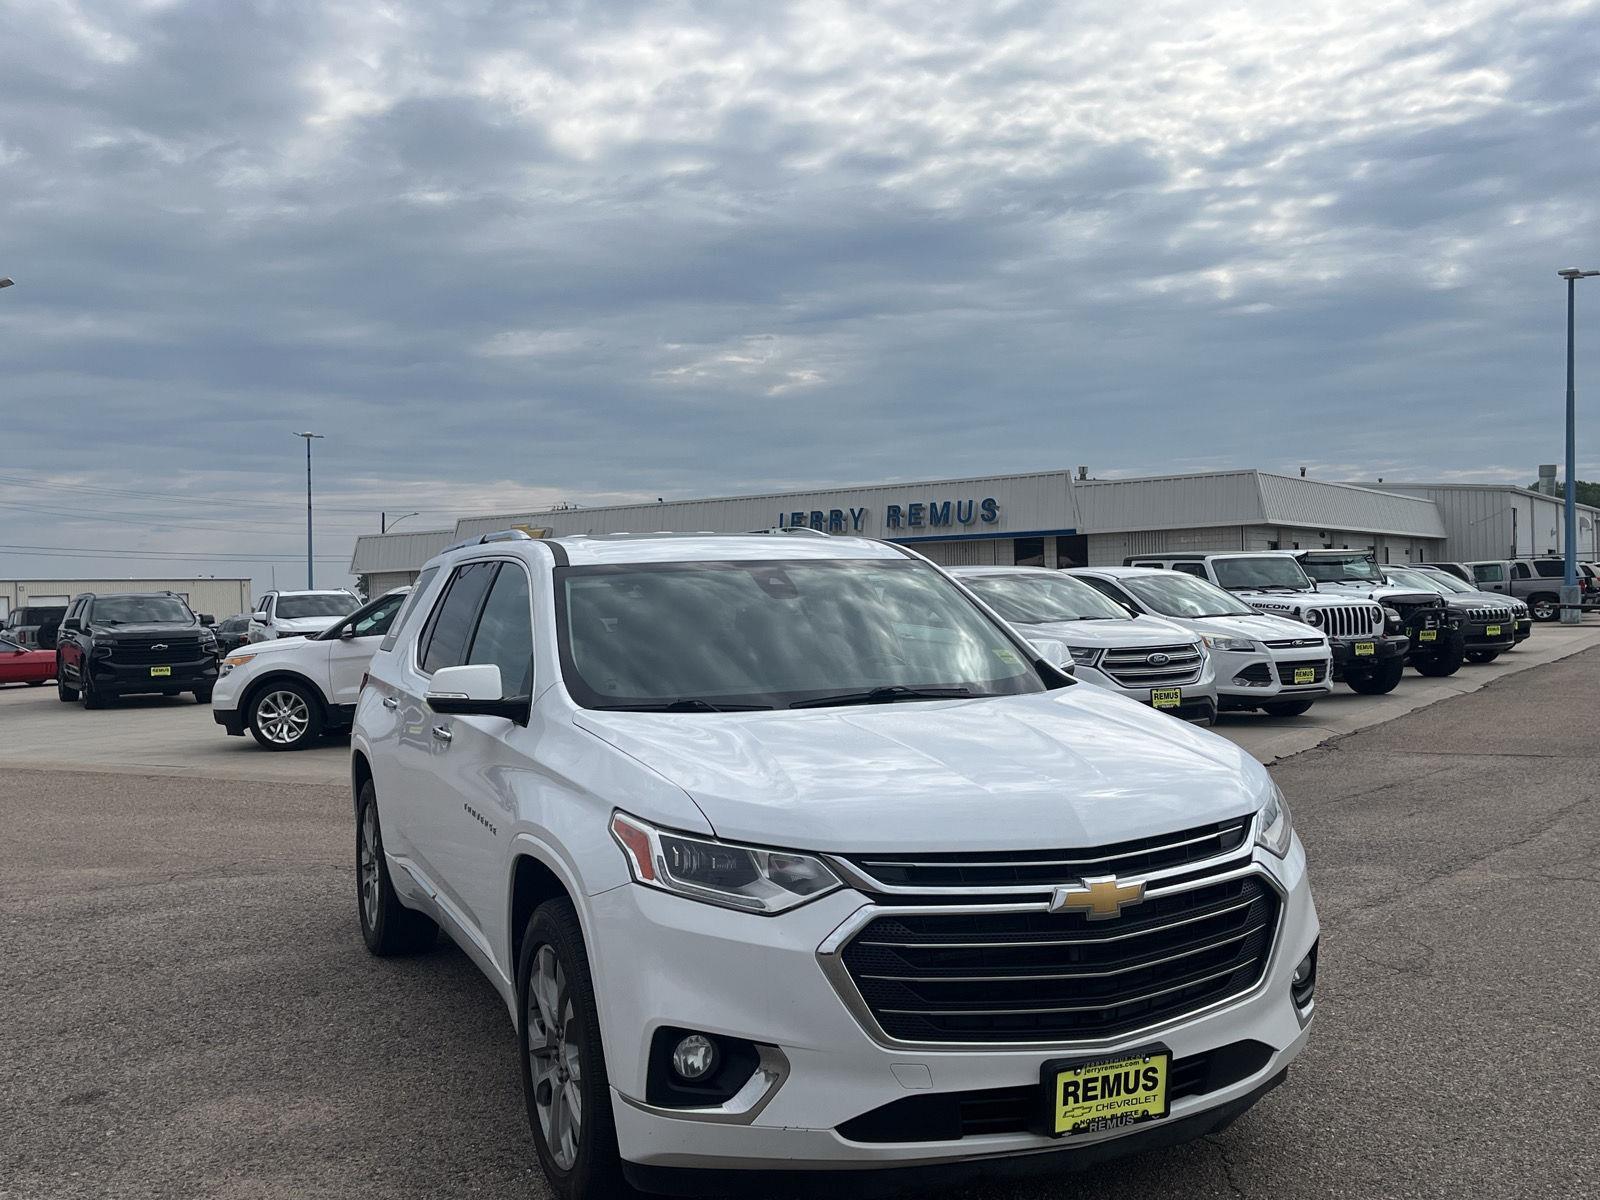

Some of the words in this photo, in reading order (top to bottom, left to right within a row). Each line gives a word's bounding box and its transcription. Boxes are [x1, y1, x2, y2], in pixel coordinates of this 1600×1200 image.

[886, 498, 1000, 528] REMUS
[1295, 670, 1314, 678] REMUS
[1154, 692, 1179, 700] REMUS
[1083, 1060, 1140, 1076] jerryremus.com
[1062, 1067, 1159, 1106] REMUS
[1095, 1094, 1159, 1112] CHEVROLET
[1089, 1116, 1134, 1132] REMUS
